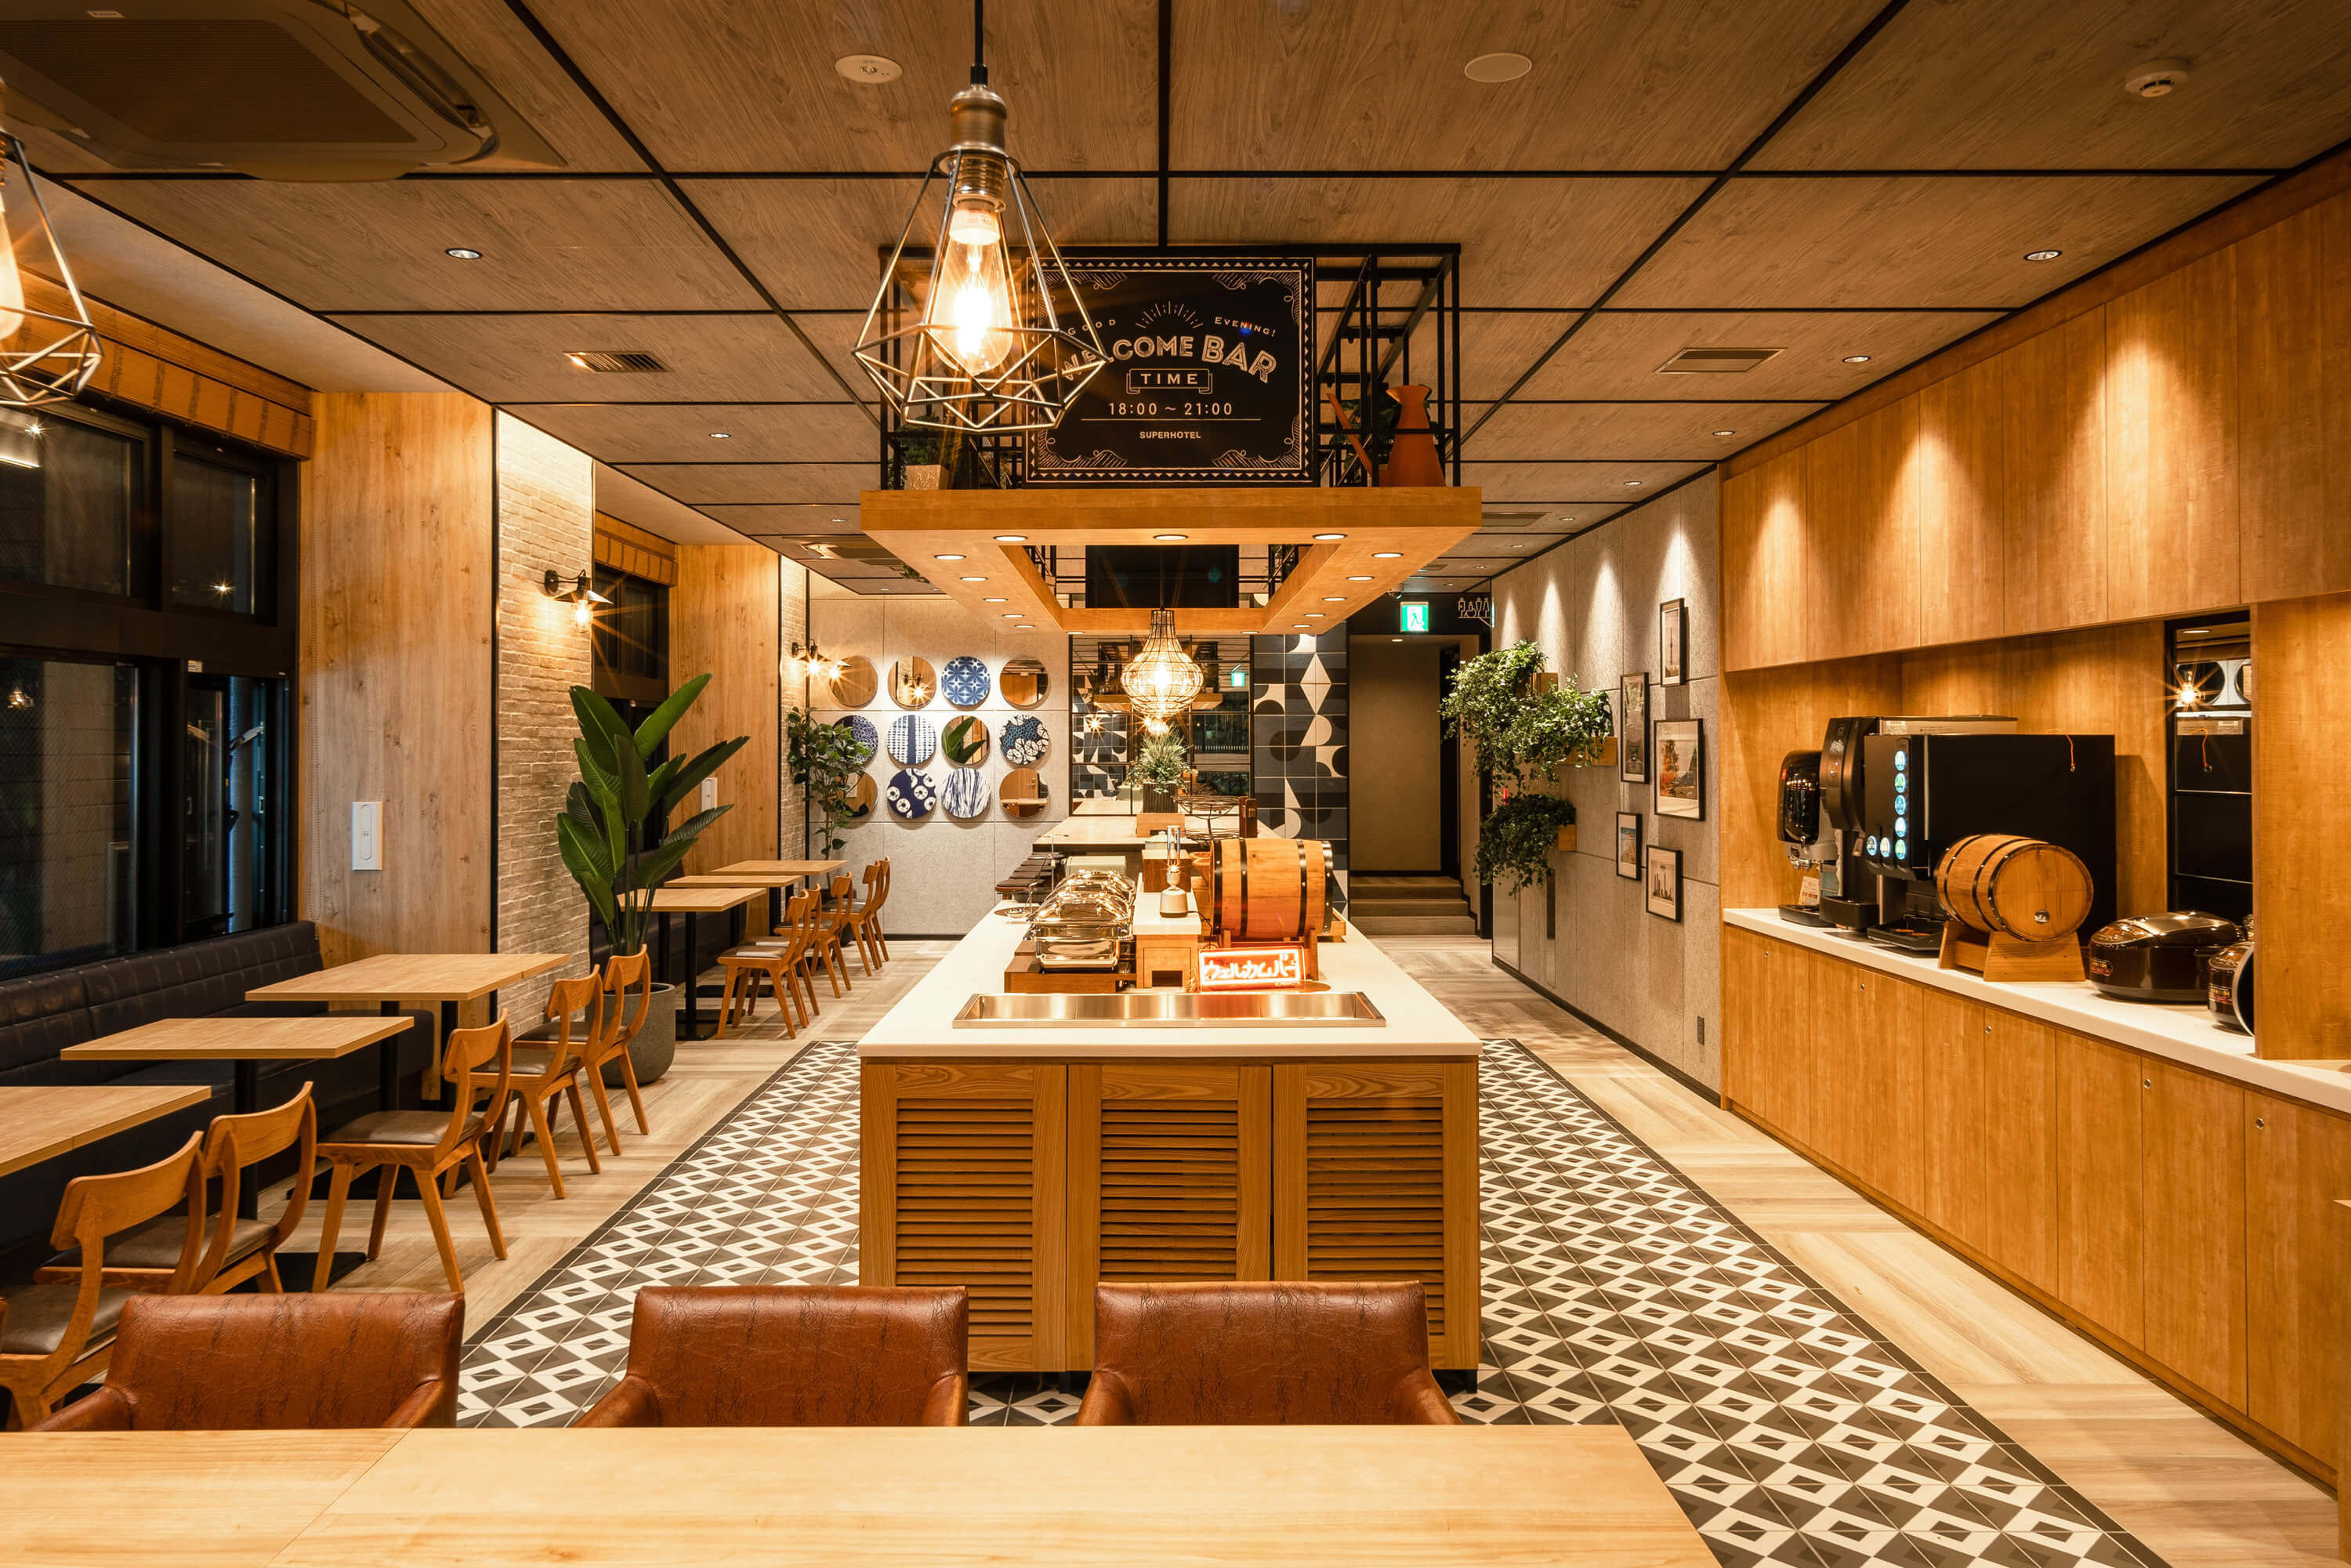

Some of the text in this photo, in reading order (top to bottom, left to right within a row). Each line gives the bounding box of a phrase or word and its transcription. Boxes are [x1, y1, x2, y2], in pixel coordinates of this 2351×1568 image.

[1067, 317, 1277, 337] GOOD EVENING!
[1201, 335, 1277, 383] BAR
[1140, 373, 1198, 385] TIME
[1109, 403, 1157, 415] 18:00
[1184, 403, 1233, 415] 21:00
[1204, 953, 1296, 979] ウェルカムバー
